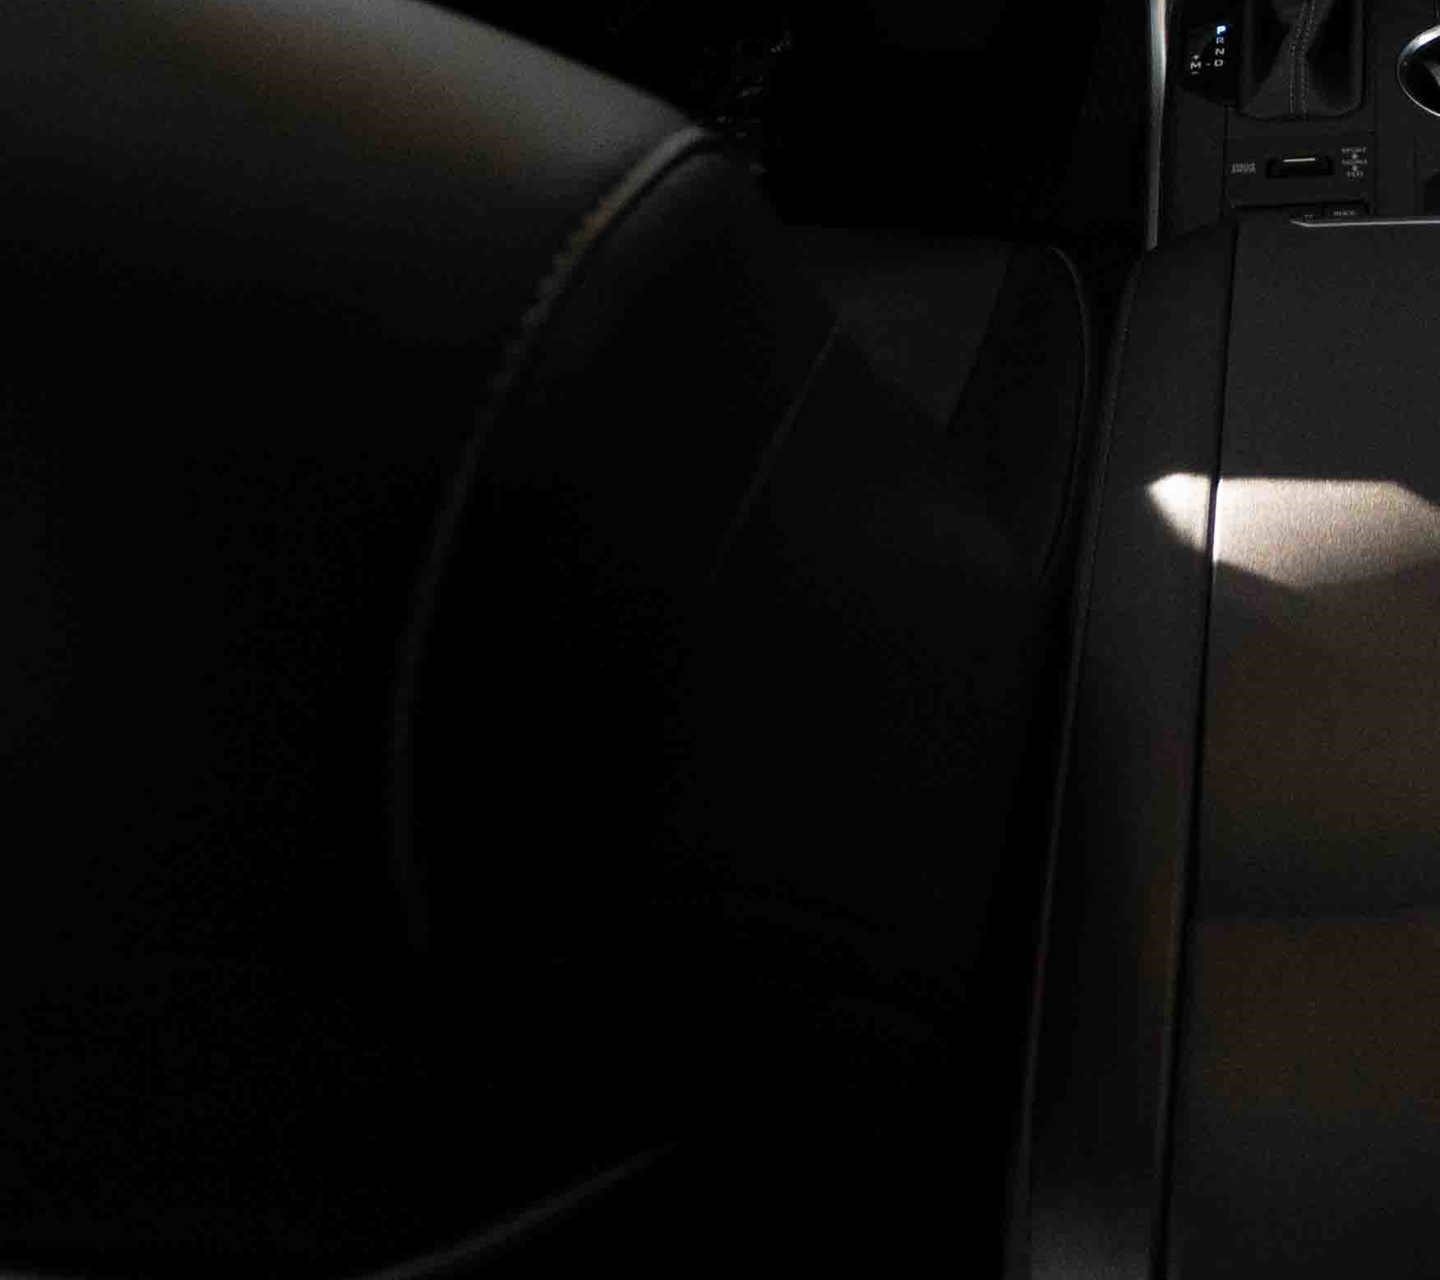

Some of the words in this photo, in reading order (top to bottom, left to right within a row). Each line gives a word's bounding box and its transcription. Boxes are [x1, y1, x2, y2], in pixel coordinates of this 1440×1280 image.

[1216, 25, 1226, 35] P
[1215, 47, 1225, 56] N
[1190, 60, 1202, 70] M
[1214, 59, 1224, 67] D
